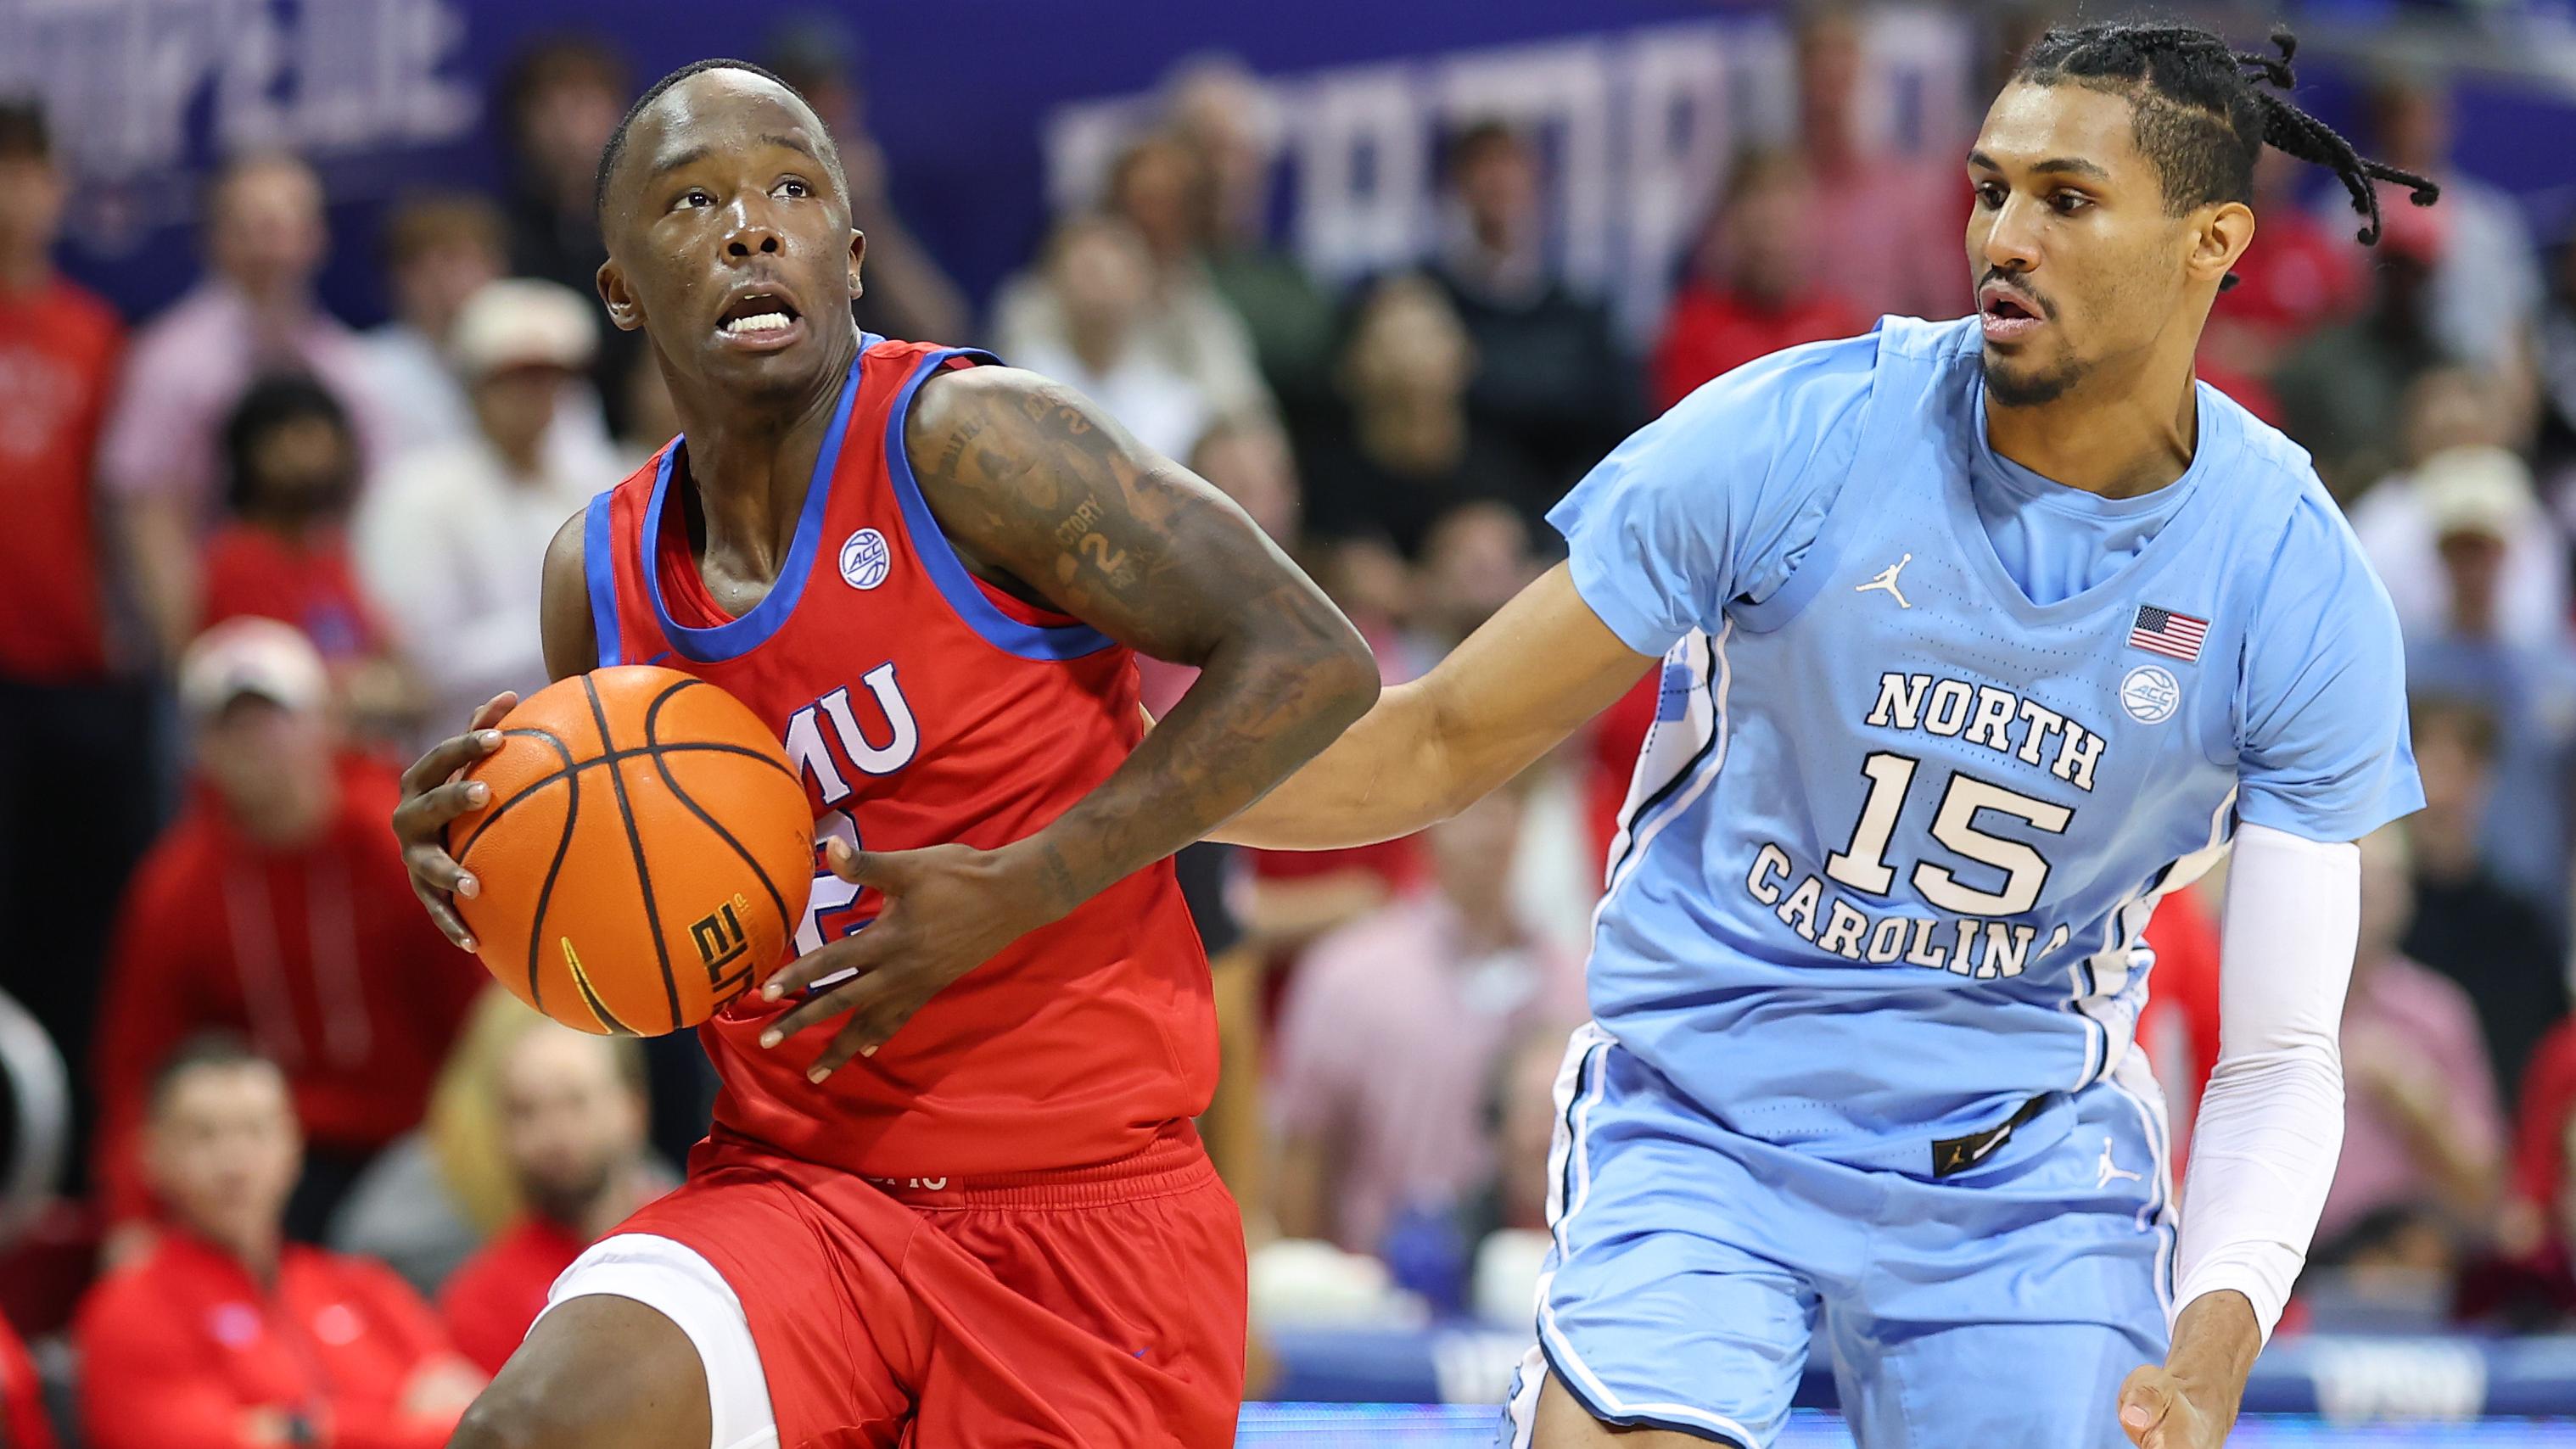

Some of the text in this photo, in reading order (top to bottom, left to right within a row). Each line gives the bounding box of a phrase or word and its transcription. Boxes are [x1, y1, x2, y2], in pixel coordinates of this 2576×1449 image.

[849, 540, 882, 570] ACC
[1080, 533, 1127, 575] 2
[784, 661, 919, 806] MU
[1864, 672, 2108, 793] NORTH
[2131, 685, 2174, 703] ACC
[1823, 750, 2076, 916] 15
